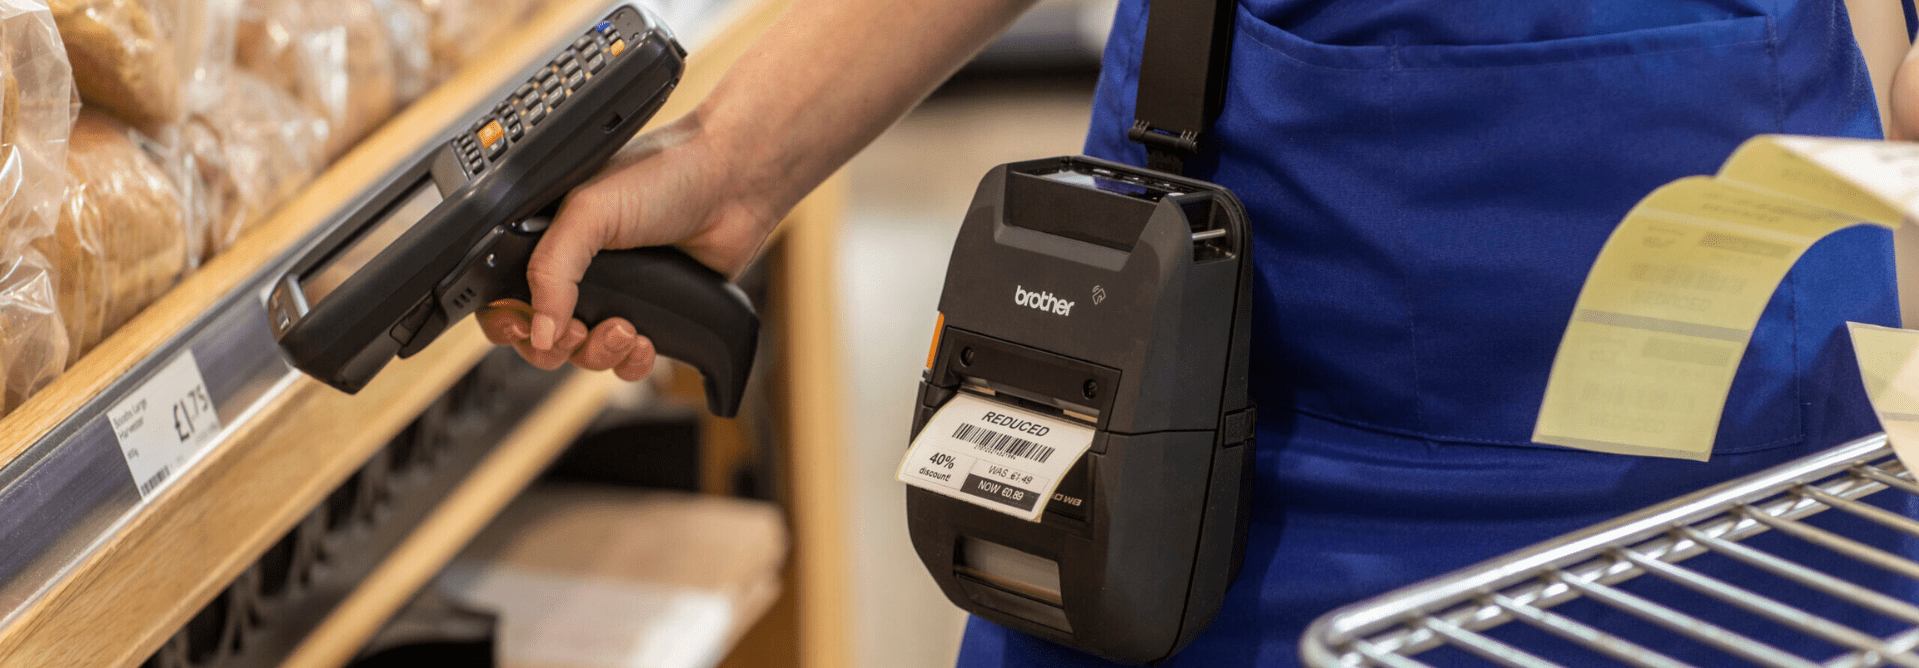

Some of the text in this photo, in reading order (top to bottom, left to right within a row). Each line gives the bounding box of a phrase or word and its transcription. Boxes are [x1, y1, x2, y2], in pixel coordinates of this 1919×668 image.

[1015, 285, 1075, 316] brother
[981, 411, 1051, 437] REDUCED
[929, 452, 956, 470] 40%
[988, 465, 1009, 478] WAS
[977, 480, 1001, 494] NOW
